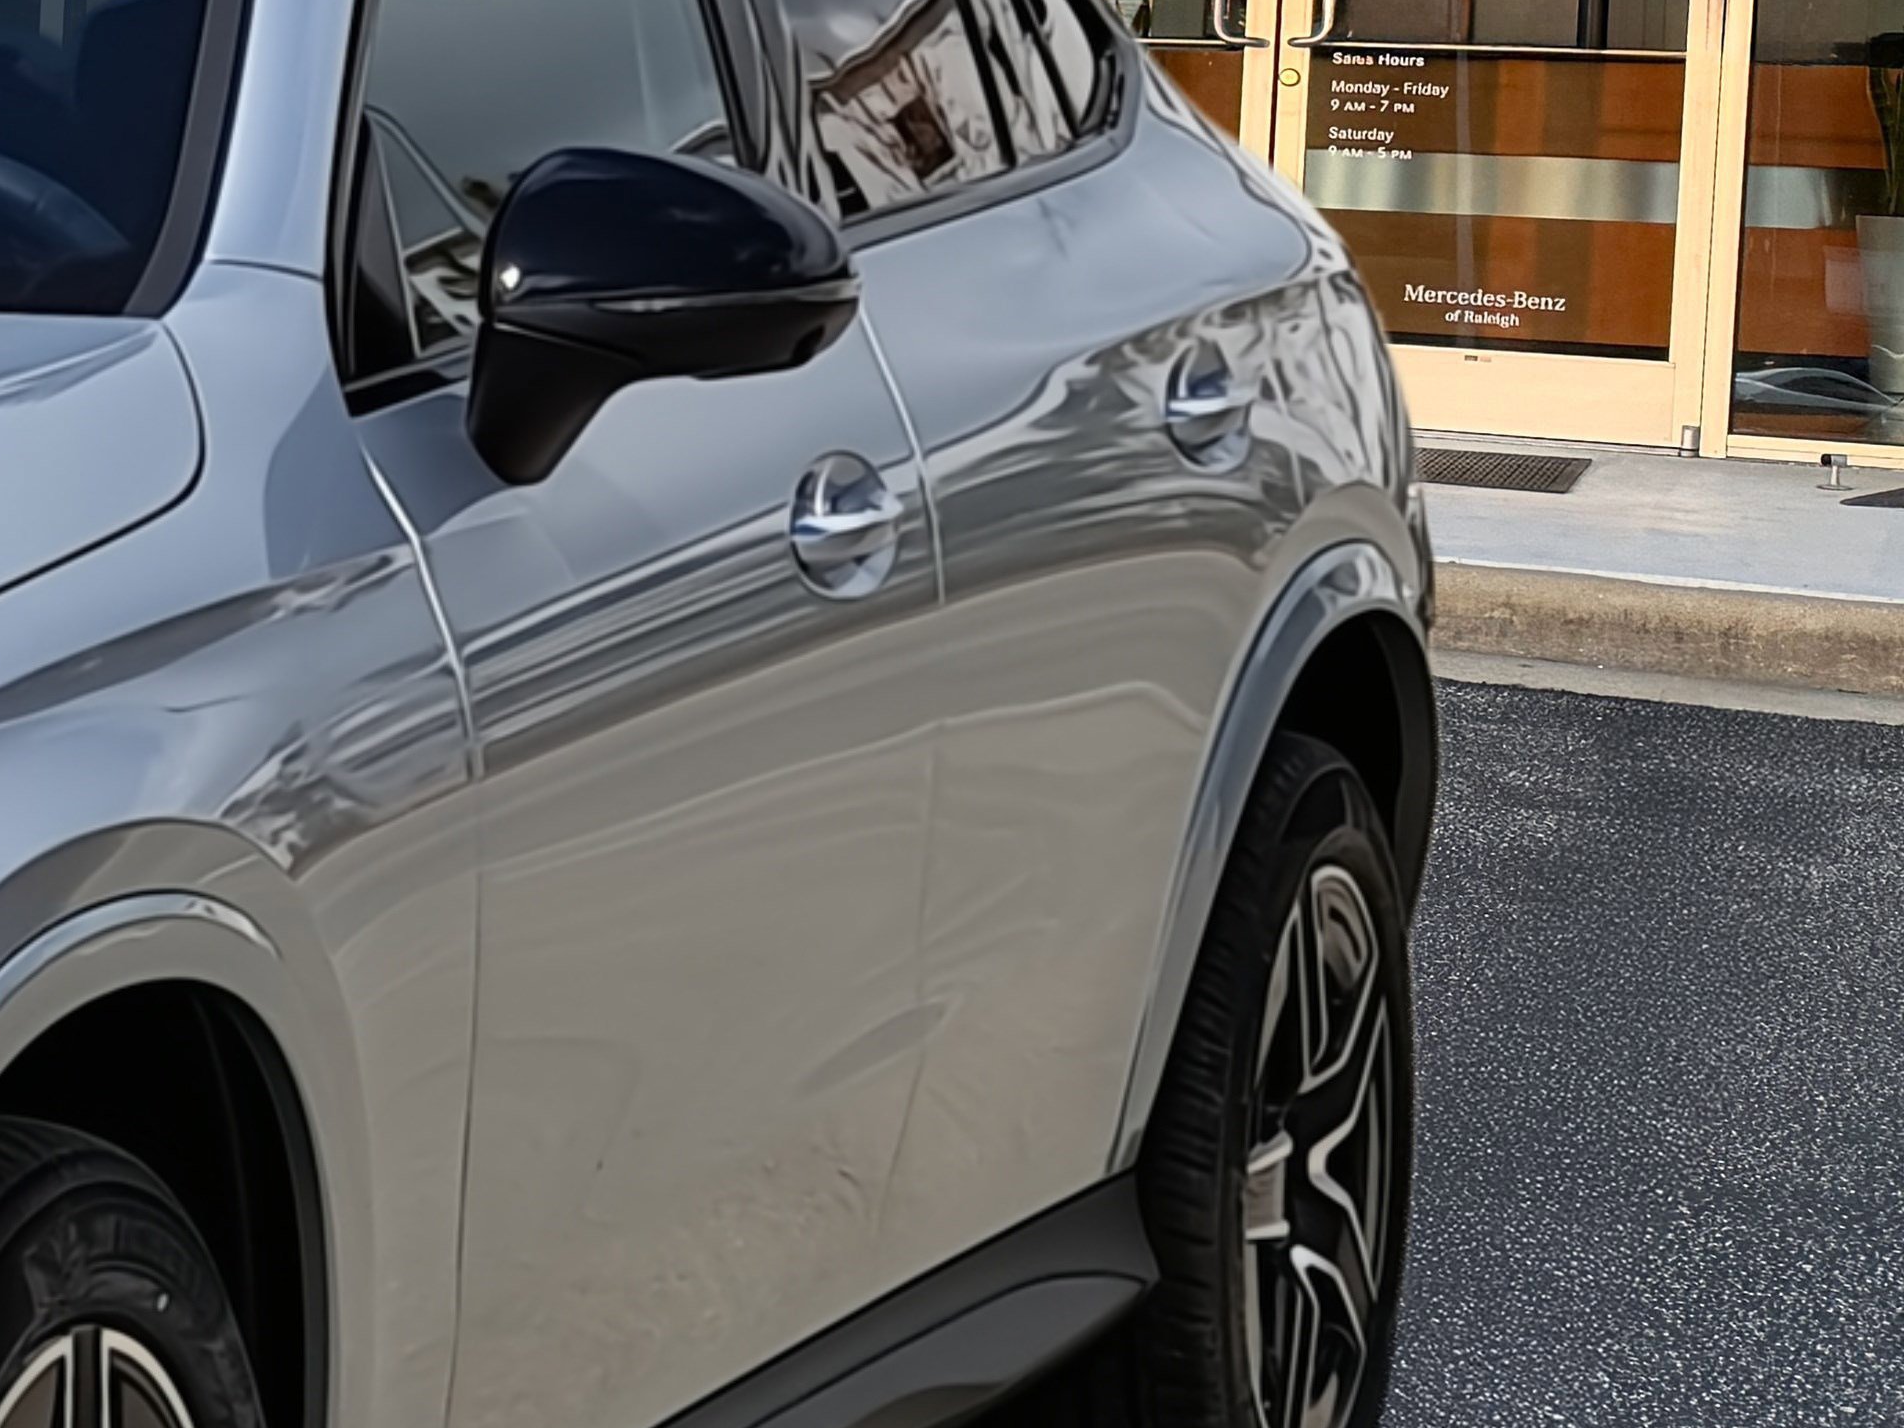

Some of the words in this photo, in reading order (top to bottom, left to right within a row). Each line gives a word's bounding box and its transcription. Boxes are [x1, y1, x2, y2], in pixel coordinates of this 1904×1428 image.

[1378, 53, 1425, 67] Hours
[1331, 80, 1390, 97] Monday
[1403, 81, 1450, 99] Friday
[1330, 99, 1339, 111] 9
[1343, 101, 1366, 112] AM
[1379, 99, 1390, 113] 7
[1393, 102, 1415, 113] PM
[1328, 126, 1395, 144] Saturday
[1328, 145, 1337, 157] 9
[1341, 148, 1364, 158] AM
[1377, 146, 1387, 160] 5
[1391, 149, 1413, 160] PM
[1403, 283, 1566, 312] Mercedes-Benz
[1444, 309, 1462, 323] of
